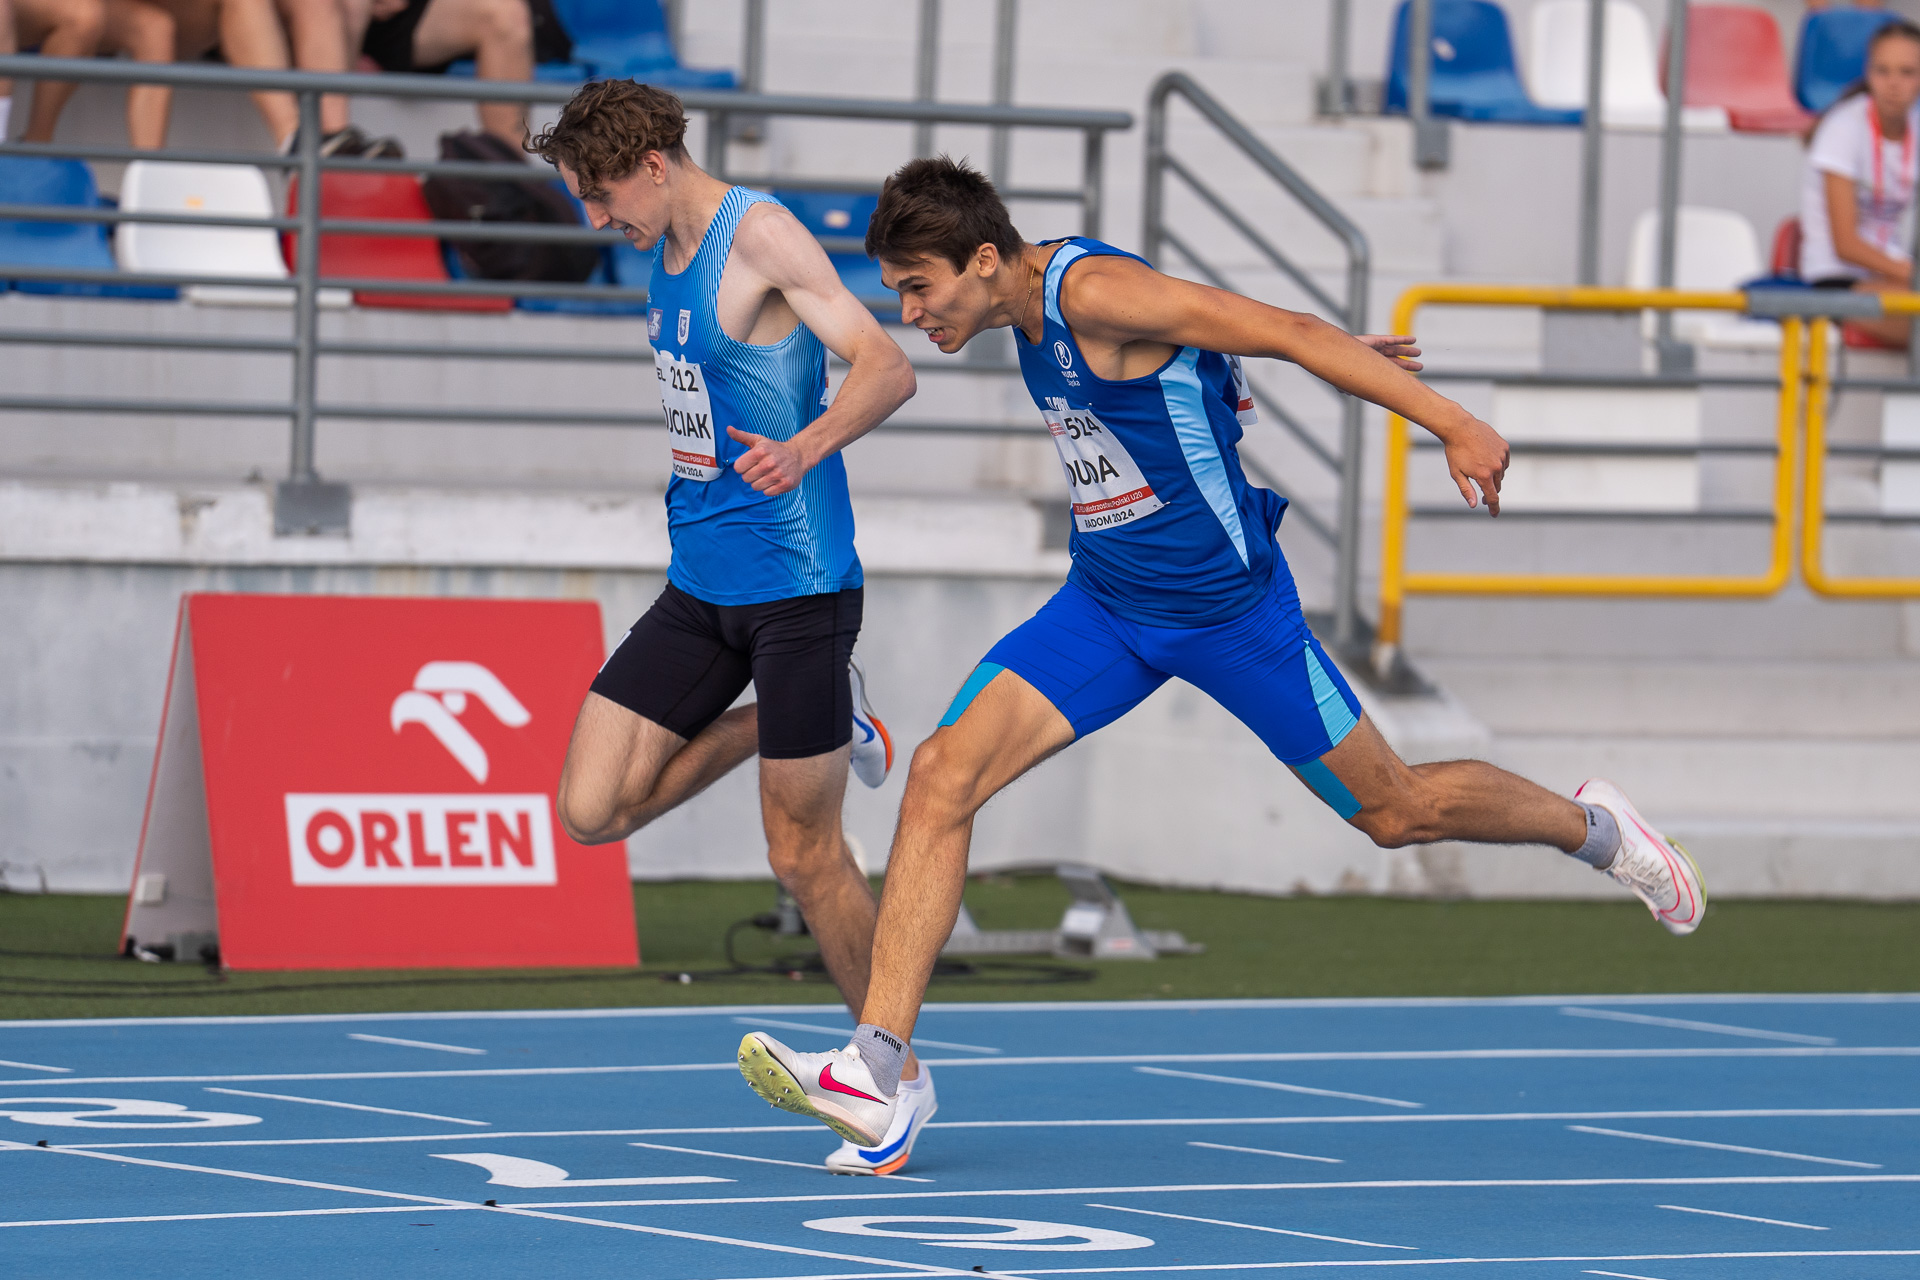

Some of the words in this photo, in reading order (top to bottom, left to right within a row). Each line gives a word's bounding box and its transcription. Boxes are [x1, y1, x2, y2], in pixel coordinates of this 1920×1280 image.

[670, 365, 699, 392] 212
[1063, 416, 1103, 440] 524
[687, 466, 704, 478] 2024
[1065, 454, 1120, 488] DUDA
[1112, 494, 1131, 508] Polski
[1131, 490, 1143, 501] U20
[1084, 514, 1113, 528] RADOM
[1113, 508, 1135, 523] 2024
[304, 807, 537, 870] ORLEN
[873, 1030, 902, 1053] PUMA
